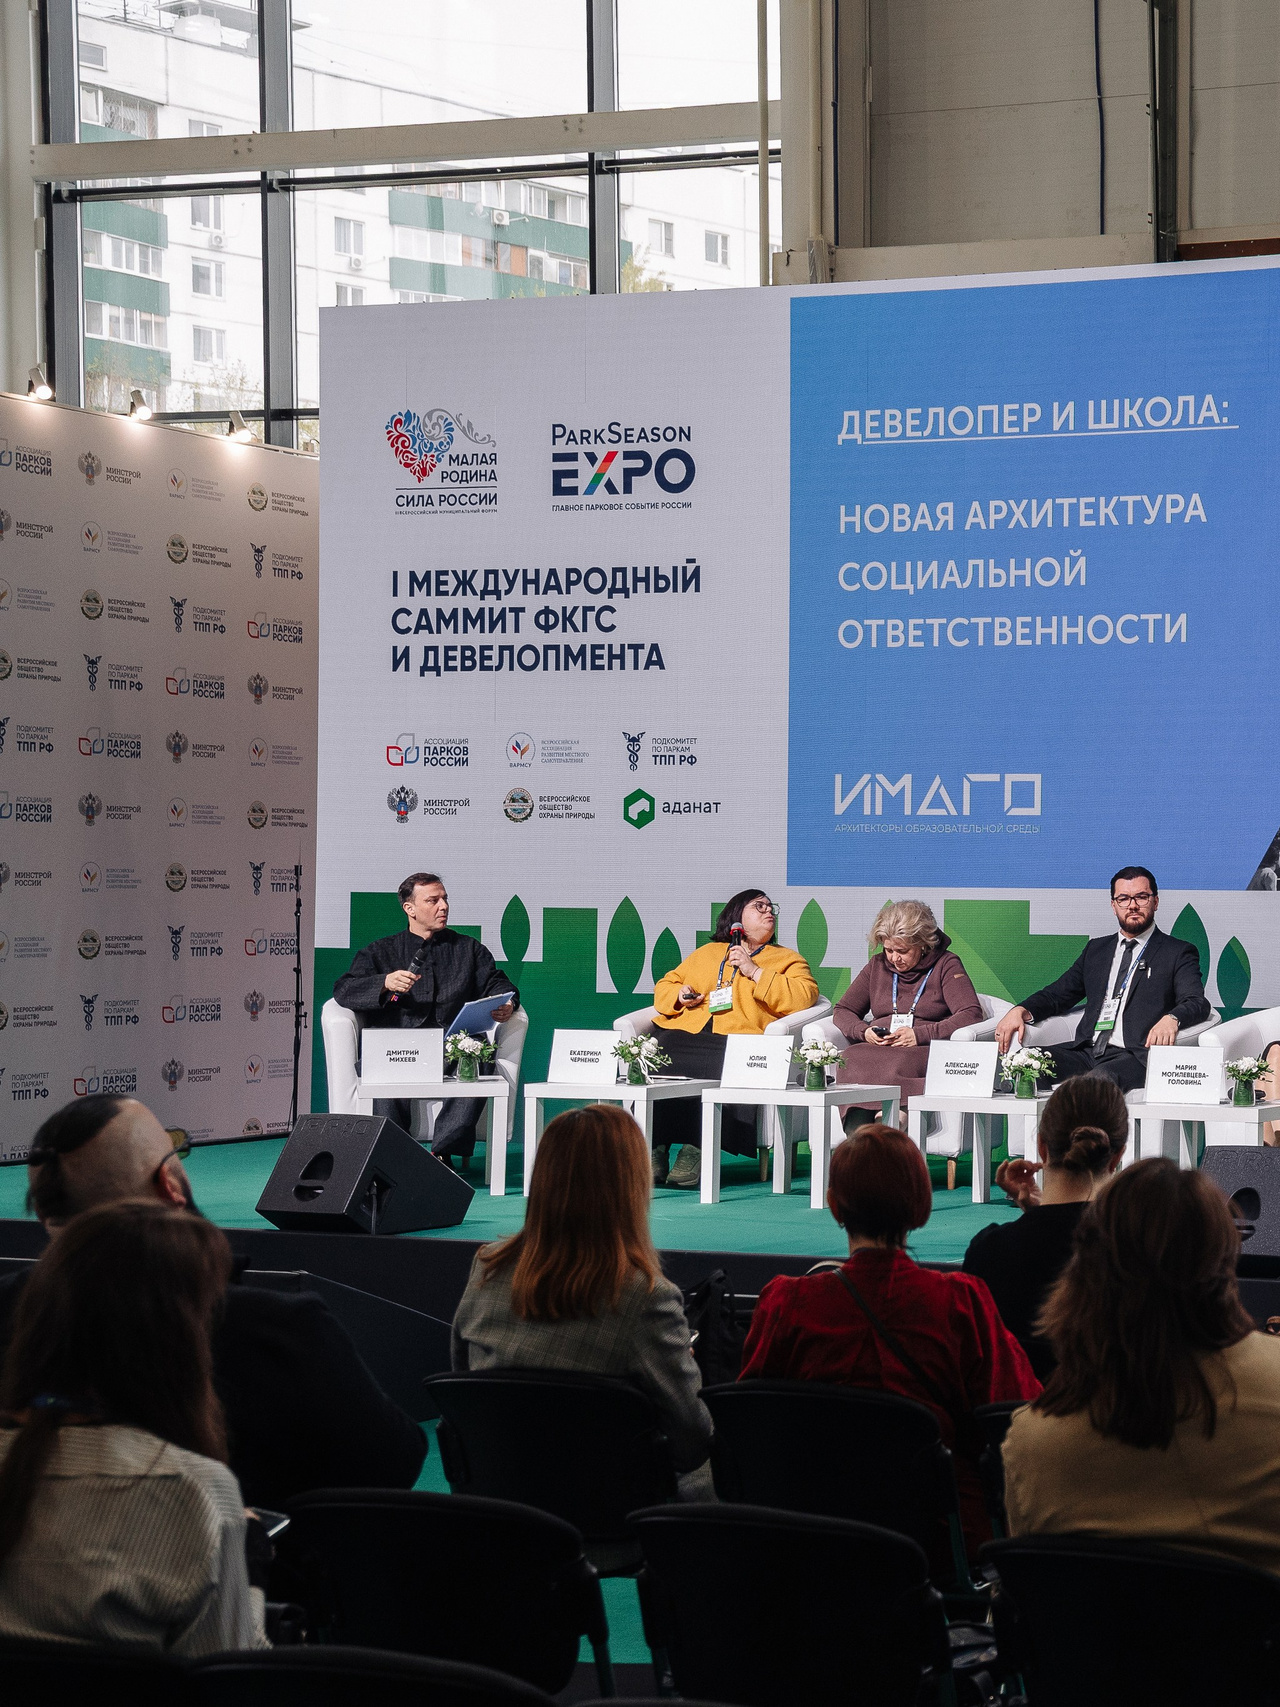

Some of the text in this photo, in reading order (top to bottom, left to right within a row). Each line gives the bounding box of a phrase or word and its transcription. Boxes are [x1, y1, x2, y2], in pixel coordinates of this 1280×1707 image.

[837, 394, 1229, 445] ДЕВЕЛОПЕР И ШКОЛА:
[15, 453, 52, 467] ПАРКОВ
[449, 453, 498, 467] МАЛАЯ
[15, 463, 52, 477] РОССИИ
[106, 466, 141, 479] МИНСТРОЙ
[551, 448, 696, 496] EXPO
[106, 475, 132, 485] РОССИИ
[441, 470, 498, 484] РОДИНА
[395, 492, 498, 508] СИЛА РОССИИ
[552, 501, 692, 512] ГЛАВНОЕ ПАРКОВОЕ СОБЫТИЕ РОССИИ
[839, 492, 1207, 534] НОВАЯ АРХИТЕКТУРА
[16, 521, 54, 533] МИНСТРОЙ
[16, 530, 44, 540] РОССИИ
[272, 567, 304, 581] ТПП РФ
[838, 549, 1087, 595] СОЦИАЛЬНОЙ
[408, 558, 701, 600] МЕЖДУНАРОДНЫЙ
[392, 604, 617, 635] САММИТ ФКГС
[193, 622, 226, 635] ТПП РФ
[272, 625, 303, 636] ПАРКОВ
[838, 613, 1187, 649] ОТВЕТСТВЕННОСТИ
[272, 633, 303, 644] РОССИИ
[392, 643, 666, 677] И ДЕВЕЛОПМЕНТА
[108, 679, 143, 692] ТПП РФ
[193, 680, 225, 691] ПАРКОВ
[272, 686, 304, 696] МИНСТРОЙ
[193, 689, 225, 700] РОССИИ
[272, 693, 295, 701] РОССИИ
[17, 741, 54, 754] ТПП РФ
[107, 740, 141, 750] ПАРКОВ
[424, 738, 469, 746] АССОЦИАЦИЯ
[107, 748, 141, 759] РОССИИ
[192, 744, 225, 753] МИНСТРОЙ
[424, 746, 469, 756] ПАРКОВ
[192, 751, 216, 759] РОССИИ
[652, 754, 697, 766] ТПП РФ
[424, 757, 469, 767] РОССИИ
[834, 773, 1042, 816] ИМАГО
[424, 798, 470, 807] МИНСТРОЙ
[539, 804, 573, 812] ОБЩЕСТВО
[16, 803, 52, 814] ПАРКОВ
[106, 805, 141, 814] МИНСТРОЙ
[662, 802, 721, 815] аданат
[16, 813, 52, 823] РОССИИ
[106, 812, 132, 820] РОССИИ
[566, 812, 596, 820] ПРИРОДЫ
[835, 822, 1040, 834] АРХИТЕКТОРЫ ОБРАЗОВАТЕЛЬНОЙ СРЕДЫ
[15, 872, 52, 880] МИНСТРОЙ
[271, 882, 287, 893] ТПП
[191, 946, 223, 957] ТПП РФ
[190, 1004, 221, 1014] ПАРКОВ
[268, 1000, 297, 1008] МИНСТРО
[105, 1014, 139, 1026] ТПП РФ
[189, 1012, 221, 1023] РОССИИ
[386, 1049, 420, 1057] ДМИТРИЙ
[188, 1067, 221, 1076] МИНСТРОЙ
[1161, 1071, 1209, 1079] МОГИЛЕВЦЕВА-
[103, 1075, 137, 1086] ПАРКОВ
[188, 1075, 211, 1083] РОССИИ
[12, 1088, 49, 1101] ТПП РФ
[103, 1084, 137, 1095] РОССИИ
